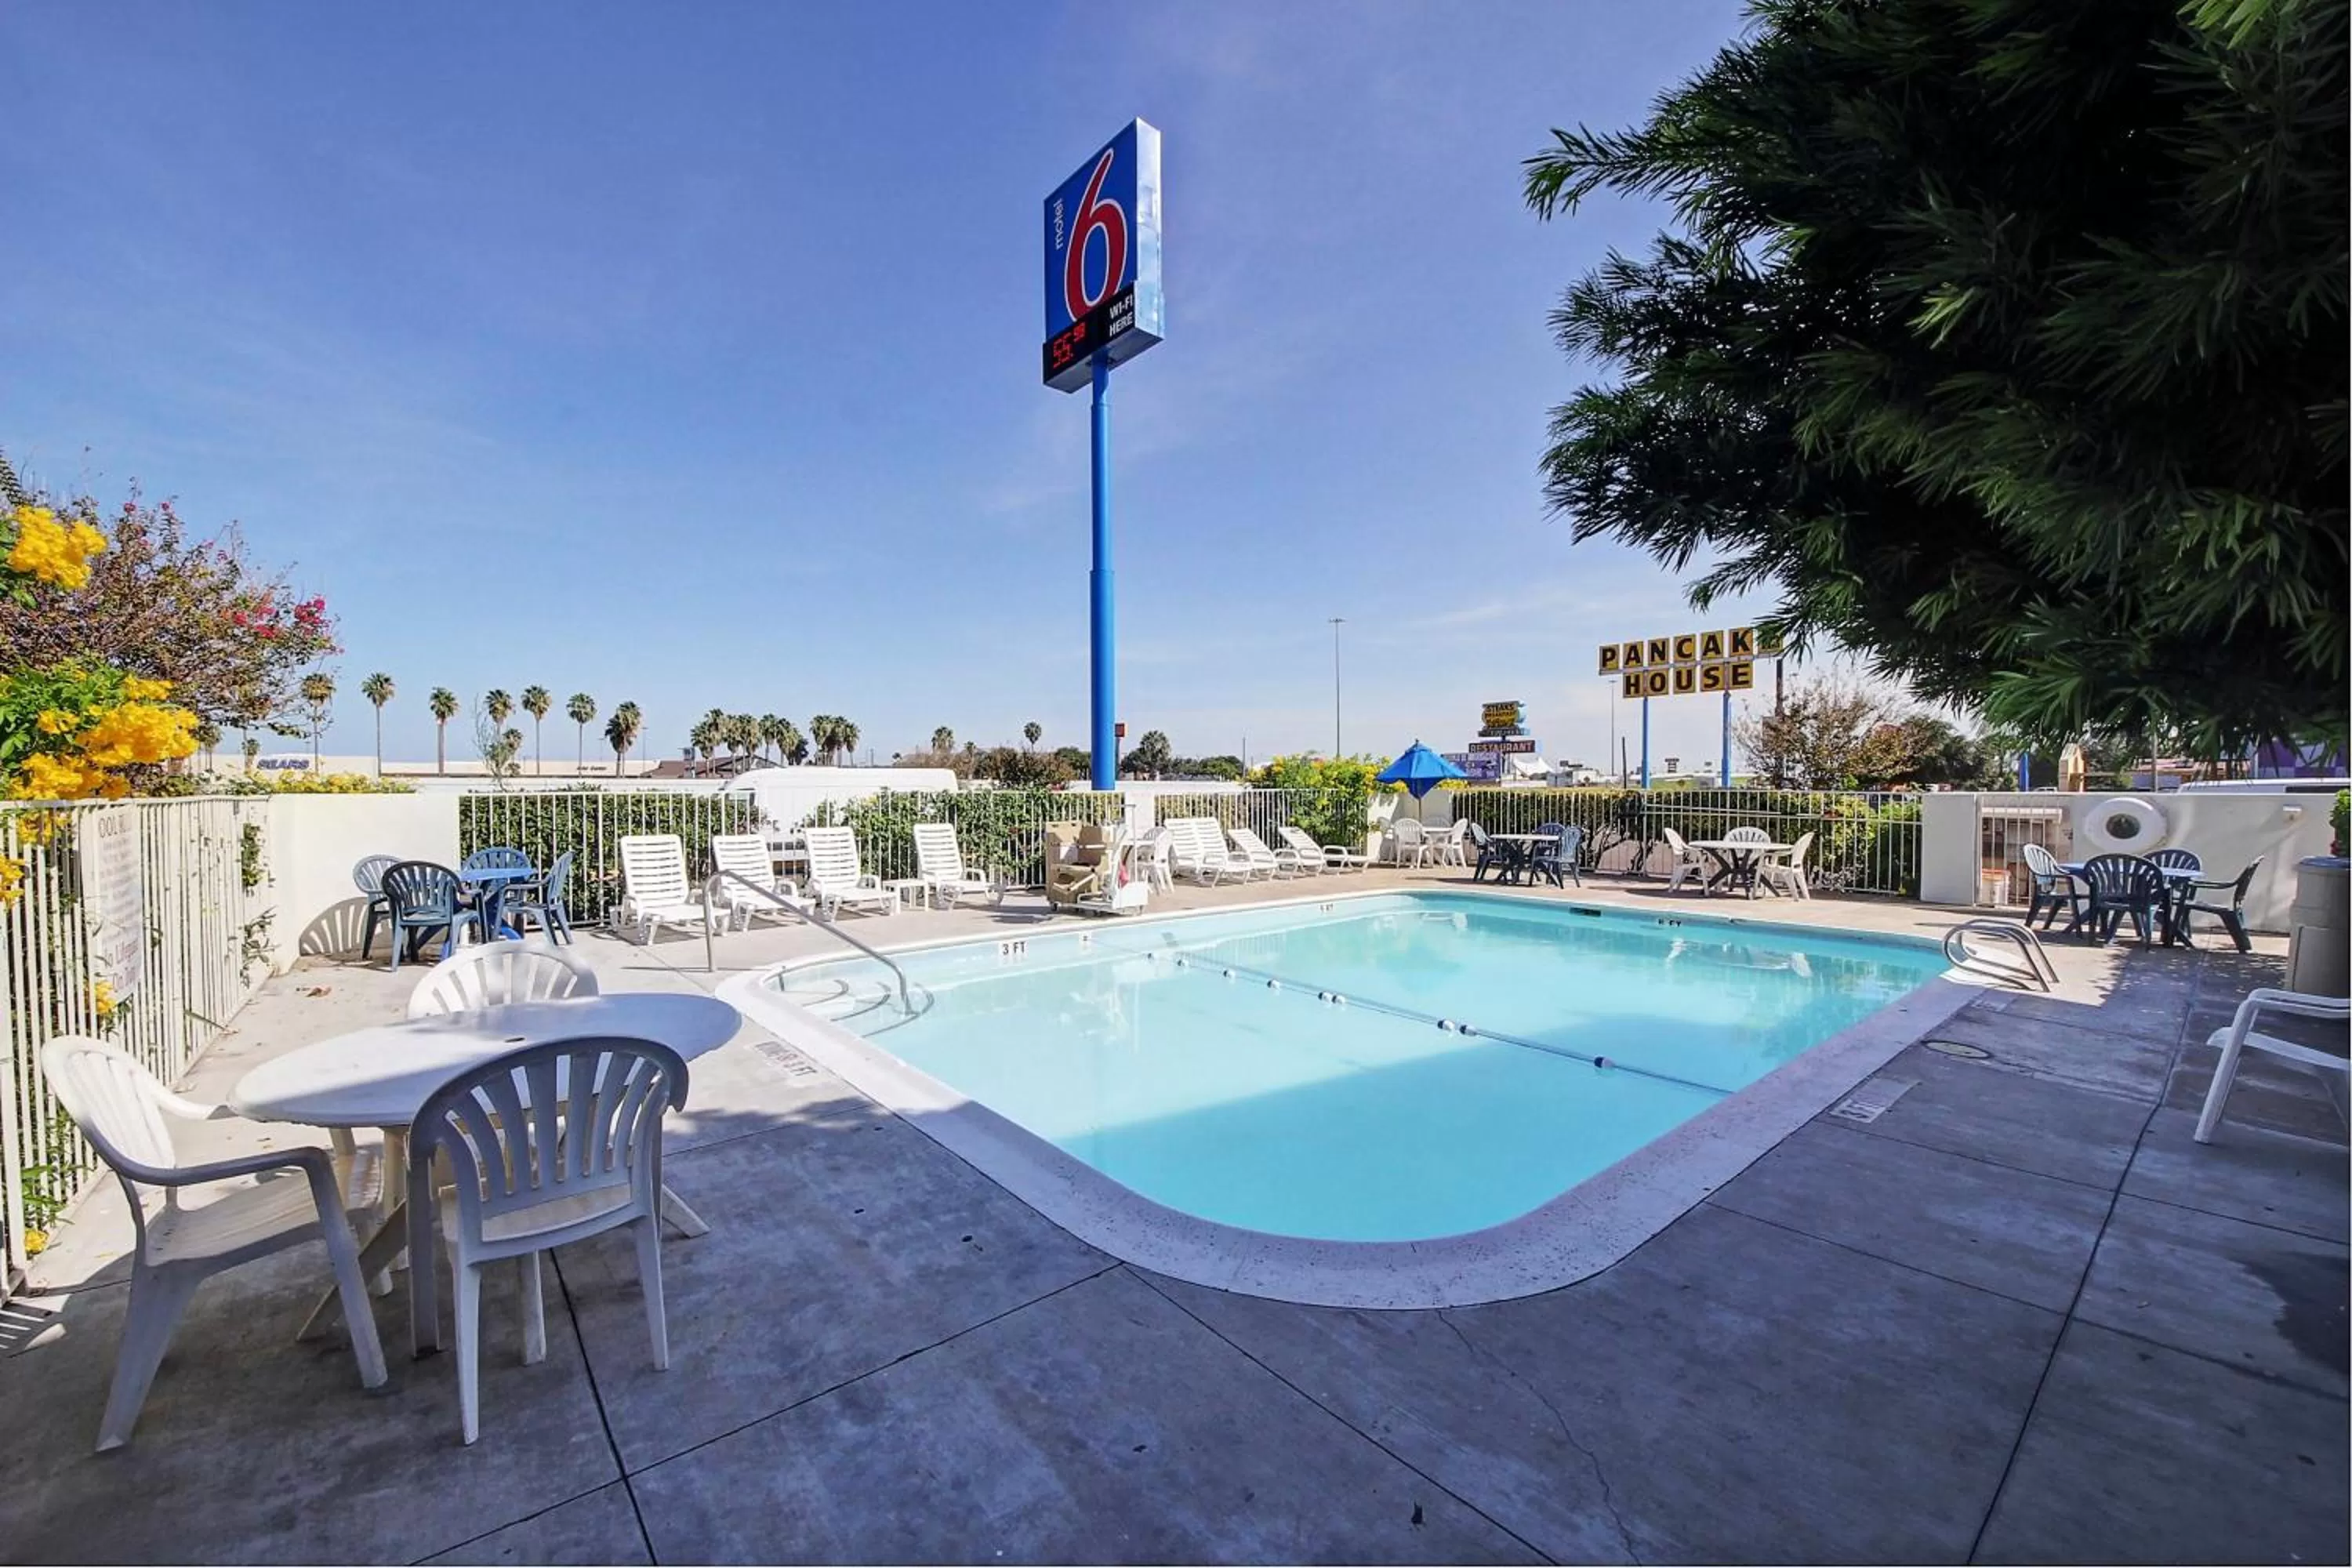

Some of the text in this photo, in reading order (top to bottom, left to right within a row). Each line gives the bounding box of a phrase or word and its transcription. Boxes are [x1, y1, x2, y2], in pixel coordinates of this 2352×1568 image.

[1054, 198, 1063, 249] motel
[1064, 147, 1127, 322] 6
[1110, 295, 1133, 318] WI-FI
[1110, 312, 1133, 337] HERE
[1602, 627, 1777, 668] PANCAK
[1625, 663, 1750, 695] HOUSE
[1470, 742, 1533, 753] RESTAURANT
[1003, 941, 1025, 955] 3 FT
